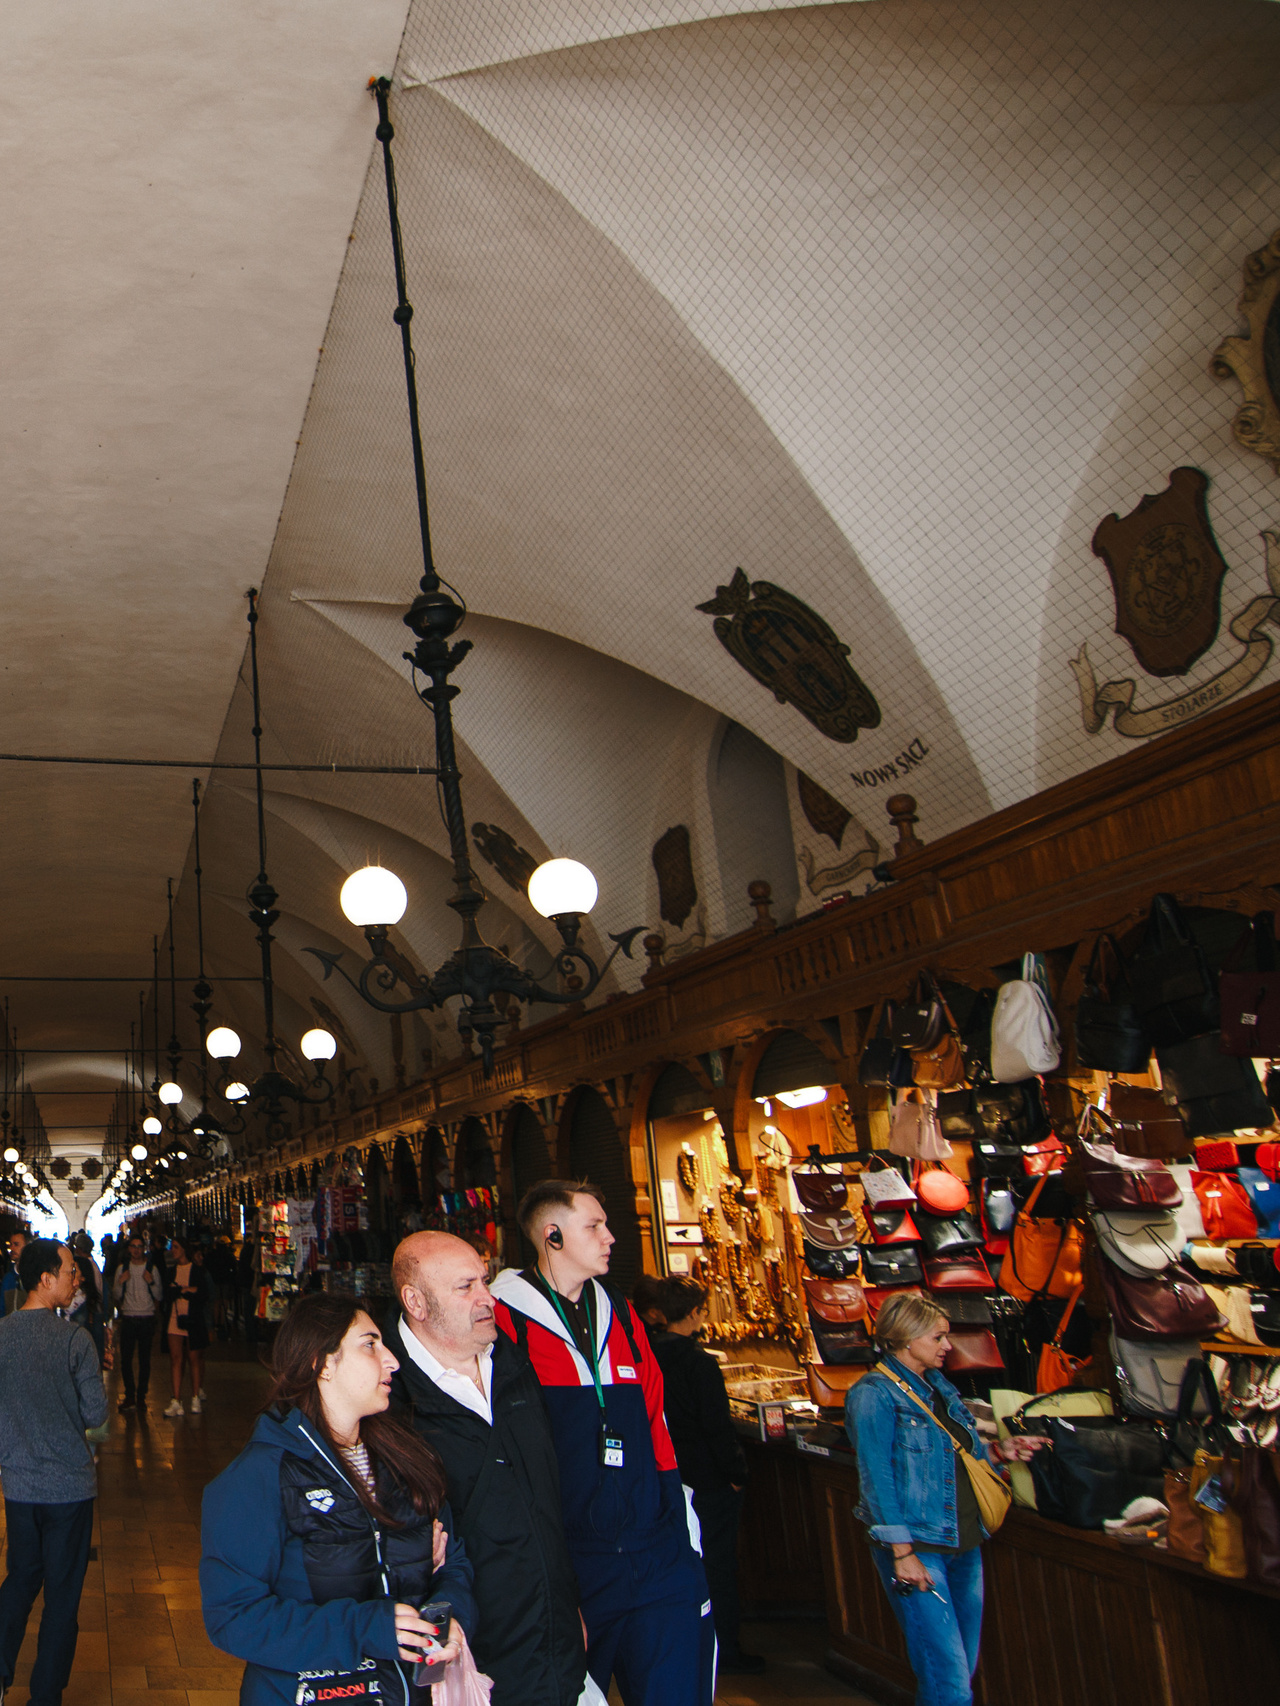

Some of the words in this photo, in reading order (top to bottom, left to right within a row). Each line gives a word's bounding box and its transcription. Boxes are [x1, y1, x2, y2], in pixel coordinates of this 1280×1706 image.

[850, 762, 900, 788] NOWY
[305, 1488, 333, 1501] arena
[317, 1682, 366, 1701] LONDON
